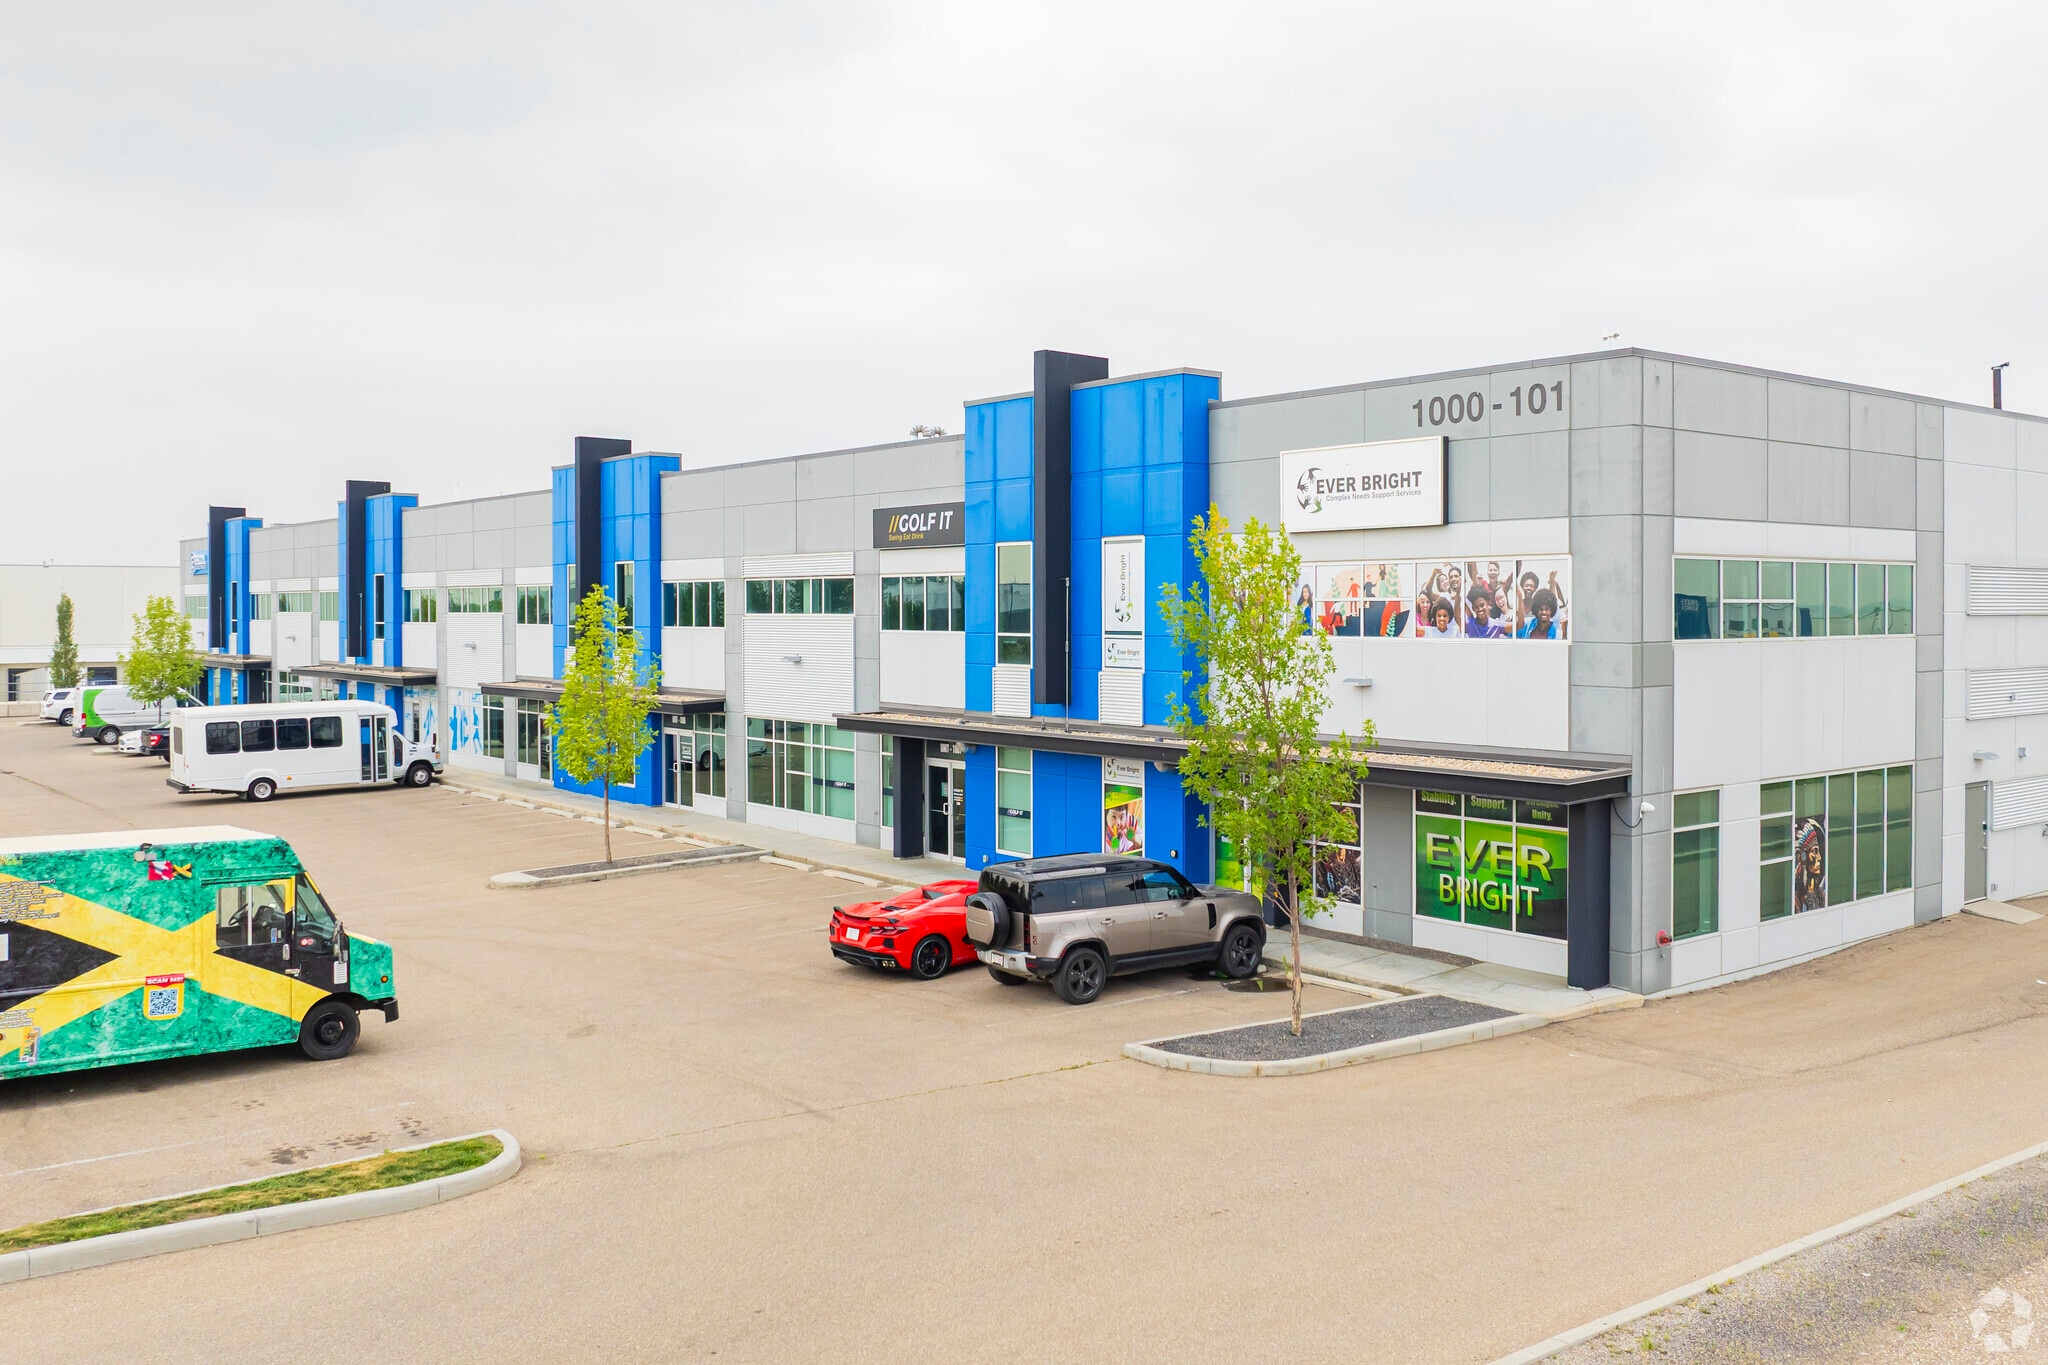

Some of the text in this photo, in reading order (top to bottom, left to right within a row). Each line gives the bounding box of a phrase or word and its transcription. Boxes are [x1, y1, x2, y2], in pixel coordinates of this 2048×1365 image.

[1316, 471, 1422, 495] EVER BRIGHT
[1326, 488, 1422, 502] Complex Needs Support Services
[939, 511, 954, 530] IT
[888, 532, 924, 542] Swing Eat Drink
[1126, 764, 1140, 774] Bright
[1471, 795, 1507, 810] Support.
[1531, 809, 1553, 821] Unity.
[1426, 833, 1552, 881] EVER
[1439, 873, 1540, 917] BRIGHT
[147, 977, 168, 985] SCAN
